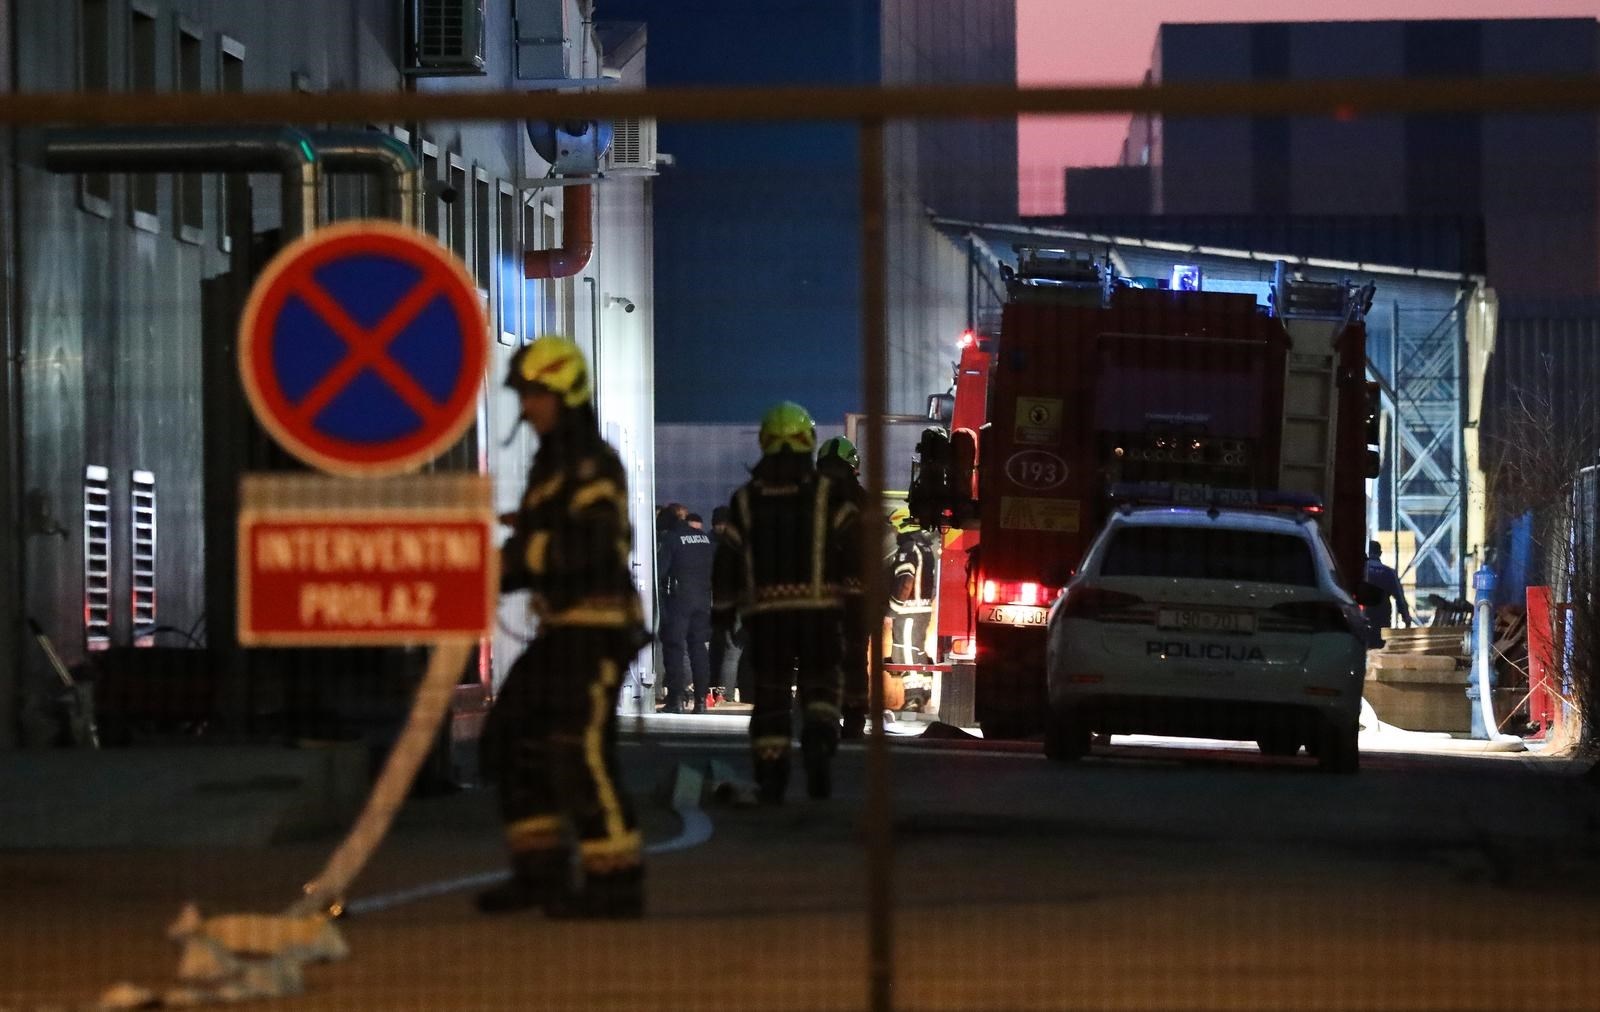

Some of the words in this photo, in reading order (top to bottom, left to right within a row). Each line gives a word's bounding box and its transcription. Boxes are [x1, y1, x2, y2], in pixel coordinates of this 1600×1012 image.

[1020, 462, 1057, 482] 193
[1178, 487, 1254, 502] POLICIJA
[680, 535, 710, 544] POLICIJA
[256, 528, 481, 572] INTERVENTNI
[298, 581, 436, 626] PROLAZ
[988, 608, 1003, 622] ZG
[1146, 641, 1265, 660] POLICIJA
